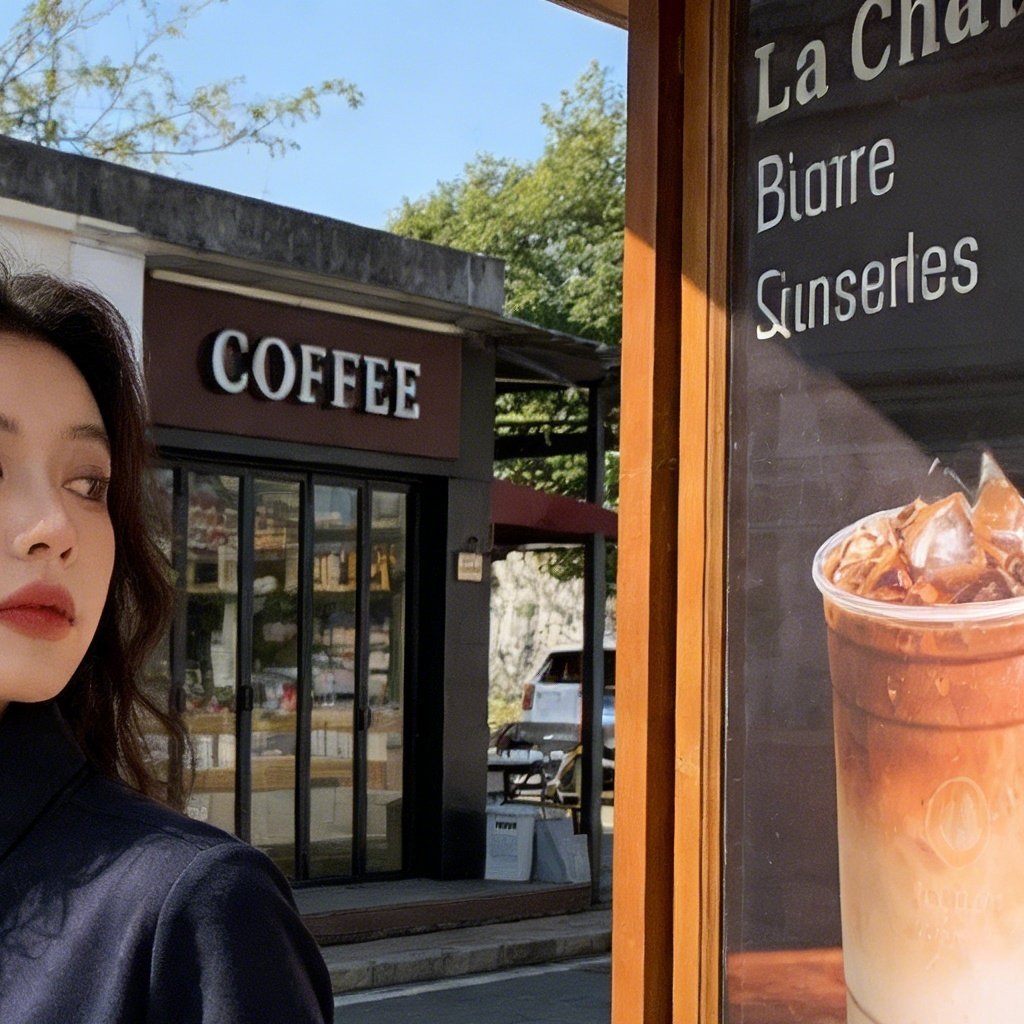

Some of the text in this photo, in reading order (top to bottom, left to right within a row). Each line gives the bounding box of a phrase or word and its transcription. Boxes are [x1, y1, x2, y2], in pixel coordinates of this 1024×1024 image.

[754, 0, 1024, 124] La Cha
[211, 328, 421, 420] COFFEE
